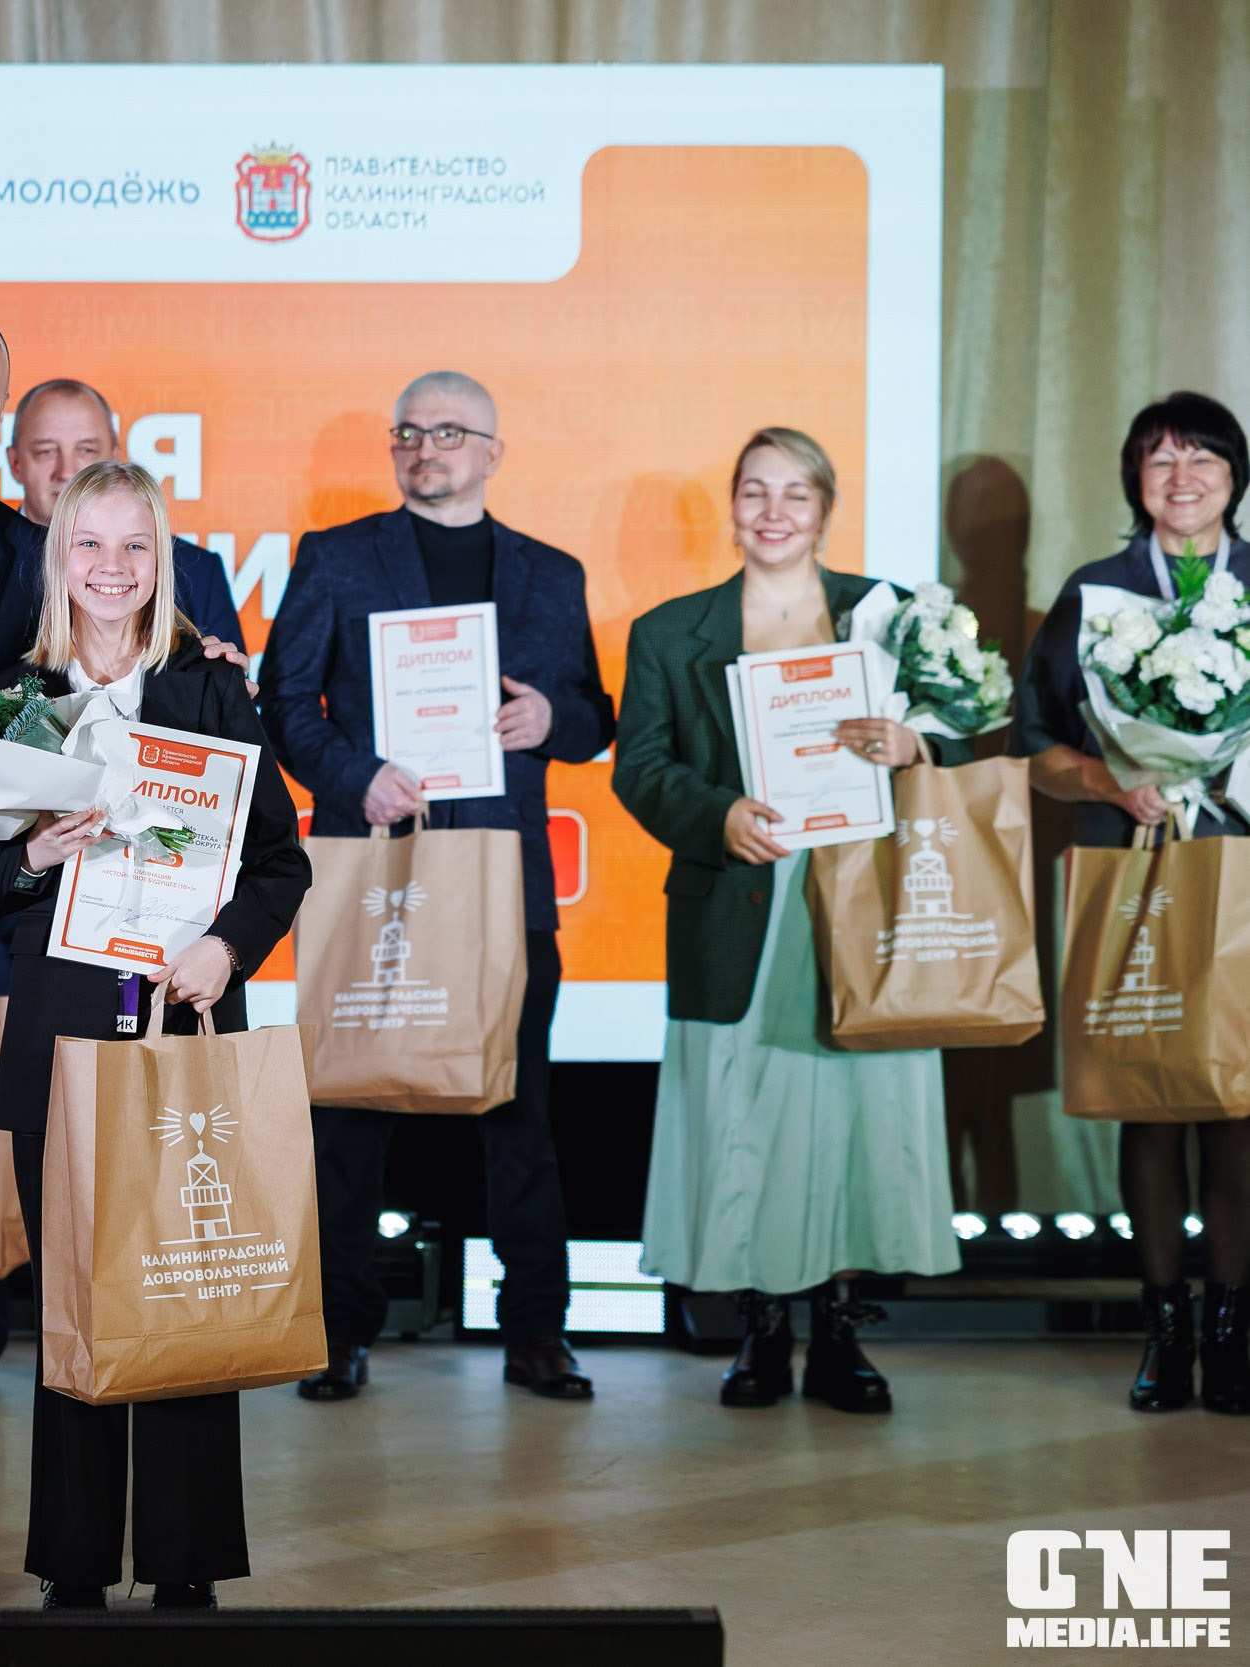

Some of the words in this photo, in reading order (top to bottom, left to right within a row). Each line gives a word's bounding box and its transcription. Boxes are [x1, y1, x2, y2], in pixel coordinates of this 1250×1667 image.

[324, 156, 507, 177] ПРАВИТЕЛЬСТВО
[324, 180, 546, 204] КАЛИНИНГРАДСКОЙ
[324, 211, 428, 231] ОБЛАСТИ
[397, 649, 474, 670] ДИПЛОМ
[769, 686, 852, 711] ДИПЛОМ
[131, 779, 220, 810] ИПЛОМ
[113, 946, 159, 960] #МЫВМЕСТЕ
[141, 1239, 286, 1268] КАЛИНИНГРАДСКИЙ
[142, 1257, 289, 1286] ДОБРОВОЛЬЧЕСКИЙ
[197, 1283, 241, 1300] ЦЕНТР
